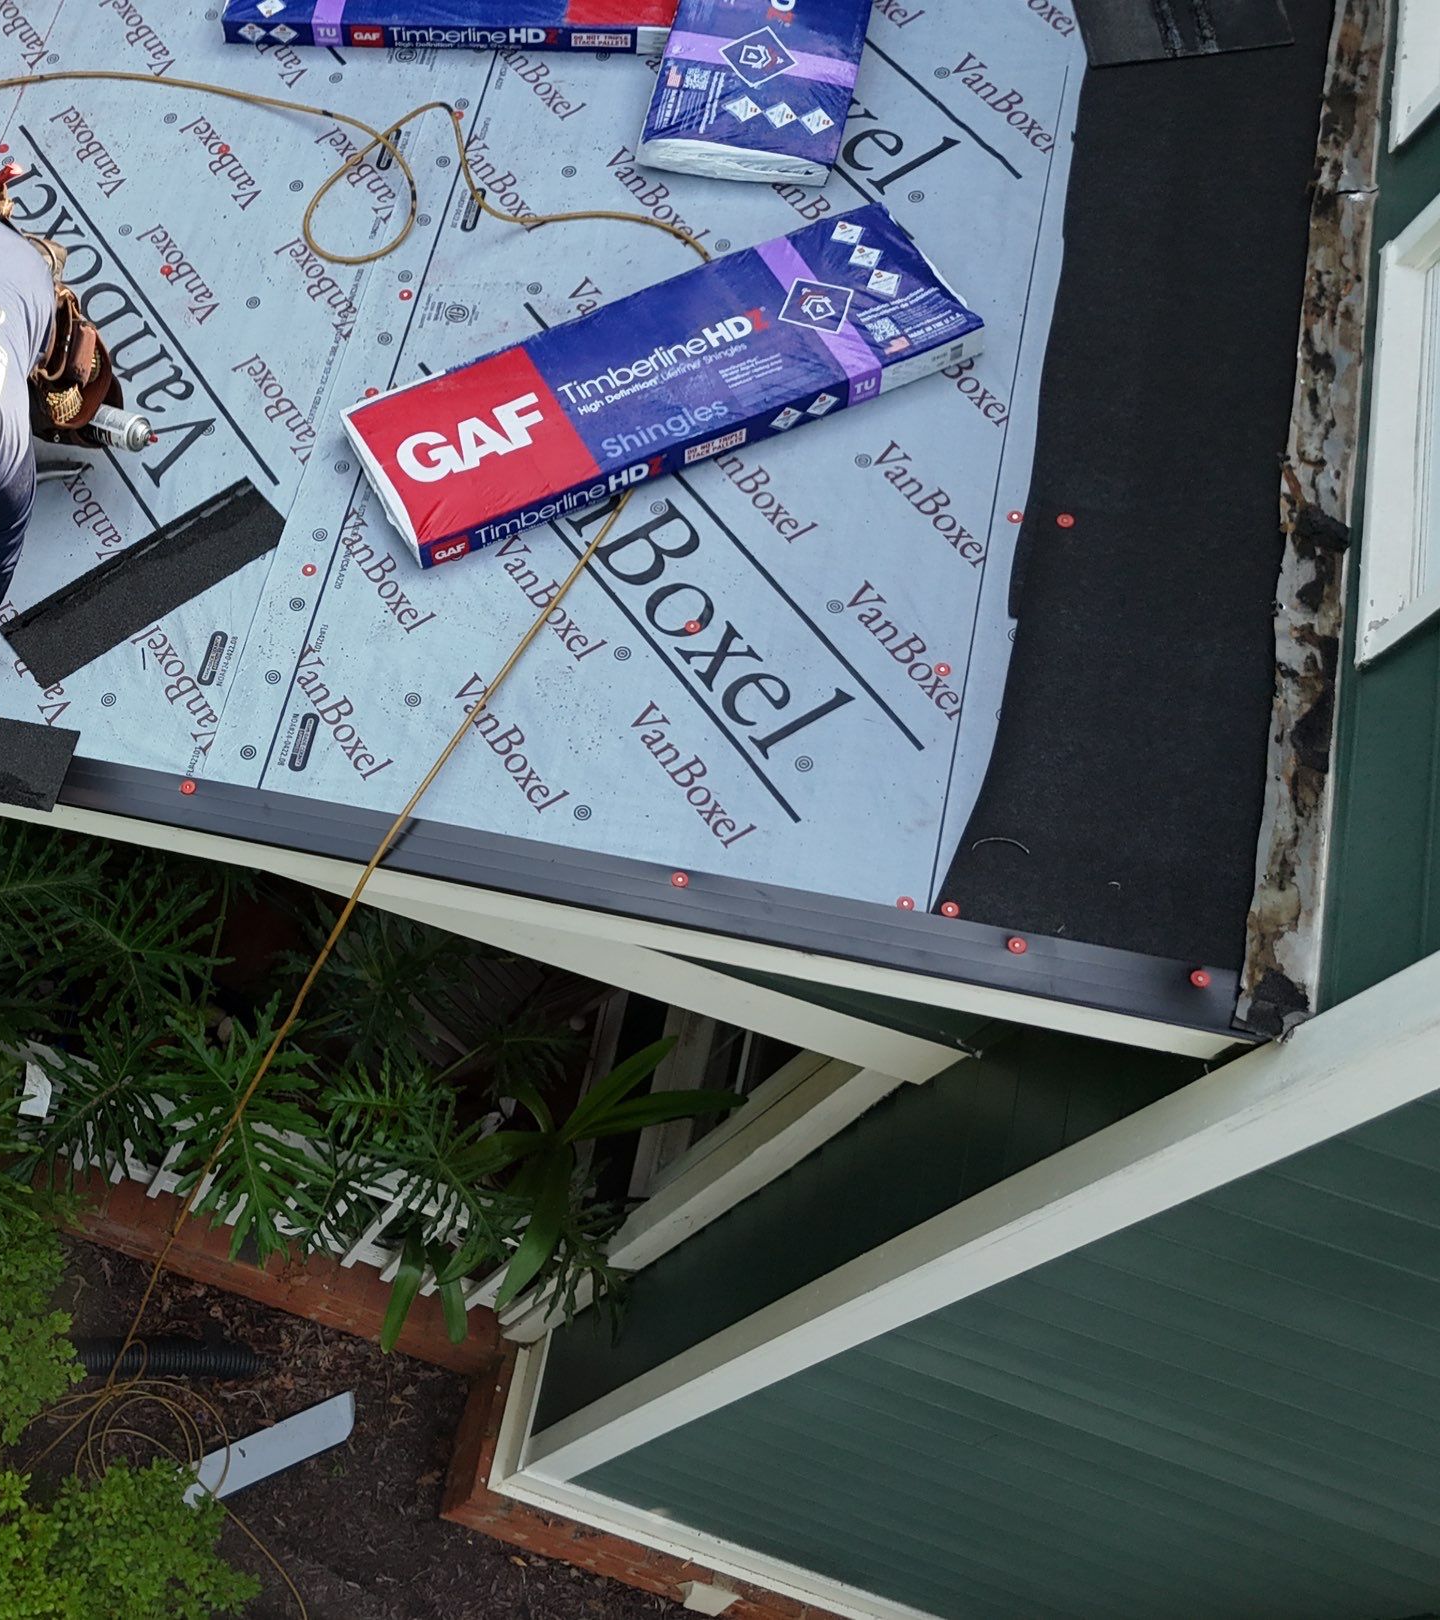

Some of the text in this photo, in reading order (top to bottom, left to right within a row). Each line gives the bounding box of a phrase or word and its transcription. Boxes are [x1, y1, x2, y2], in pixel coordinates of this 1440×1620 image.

[317, 27, 336, 38] TU
[352, 31, 382, 42] GAF
[500, 48, 587, 121] anBoxel
[951, 52, 1055, 154] VanBoxel
[49, 105, 127, 199] VanBoxel
[178, 116, 262, 211] VanBoxel
[314, 126, 397, 224] VanBoxel
[135, 223, 220, 325] VanBoxel
[273, 237, 357, 341] VanBoxel
[231, 353, 316, 465] VanBoxel
[577, 398, 604, 416] High
[601, 400, 729, 459] Shingles
[854, 377, 877, 395] TU
[941, 357, 1009, 428] Boxel
[396, 392, 544, 483] GAF
[687, 436, 744, 462] STACK PALLETS
[700, 441, 715, 451] NOT
[718, 430, 744, 445] TRIPLE
[63, 463, 127, 560] anBox
[713, 455, 819, 544] nBoxel
[873, 440, 986, 569] VanBoxel
[334, 572, 345, 590] A220
[341, 507, 437, 634] VanBoxel
[434, 543, 466, 561] GAF
[495, 535, 608, 662] VanBoxel
[565, 495, 856, 760] Boxel
[846, 580, 961, 721] VanBoxel
[130, 625, 219, 756] VanBoxel
[295, 643, 394, 782] VanBoxel
[454, 672, 570, 814] VanBoxel
[630, 700, 758, 849] VanBoxel
